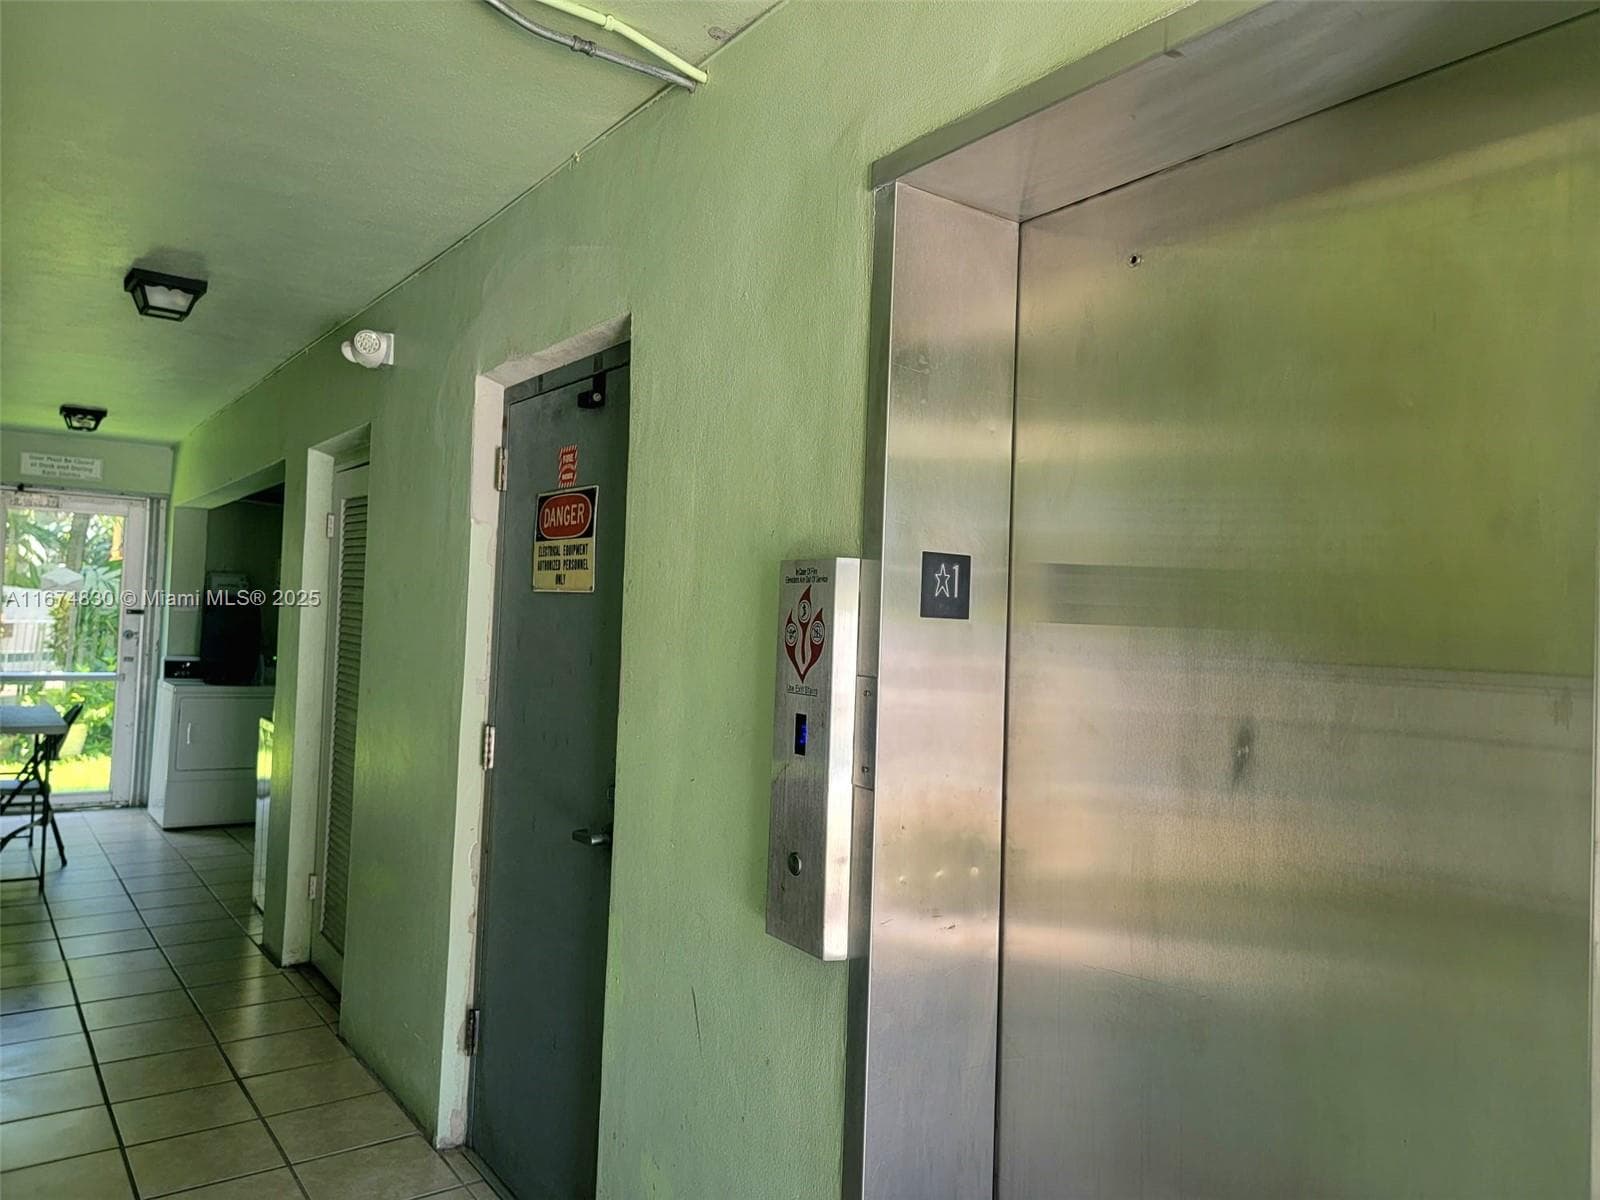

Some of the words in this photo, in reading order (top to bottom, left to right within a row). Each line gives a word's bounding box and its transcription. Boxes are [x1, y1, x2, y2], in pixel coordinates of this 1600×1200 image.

[543, 503, 585, 529] DANGER
[538, 545, 561, 557] ELECTRICAL
[563, 543, 589, 556] EQUIPMENT
[537, 559, 561, 571] AUTHORIZED
[562, 558, 589, 570] PERSONNEL
[555, 574, 566, 585] ONLY
[952, 564, 960, 598] 1
